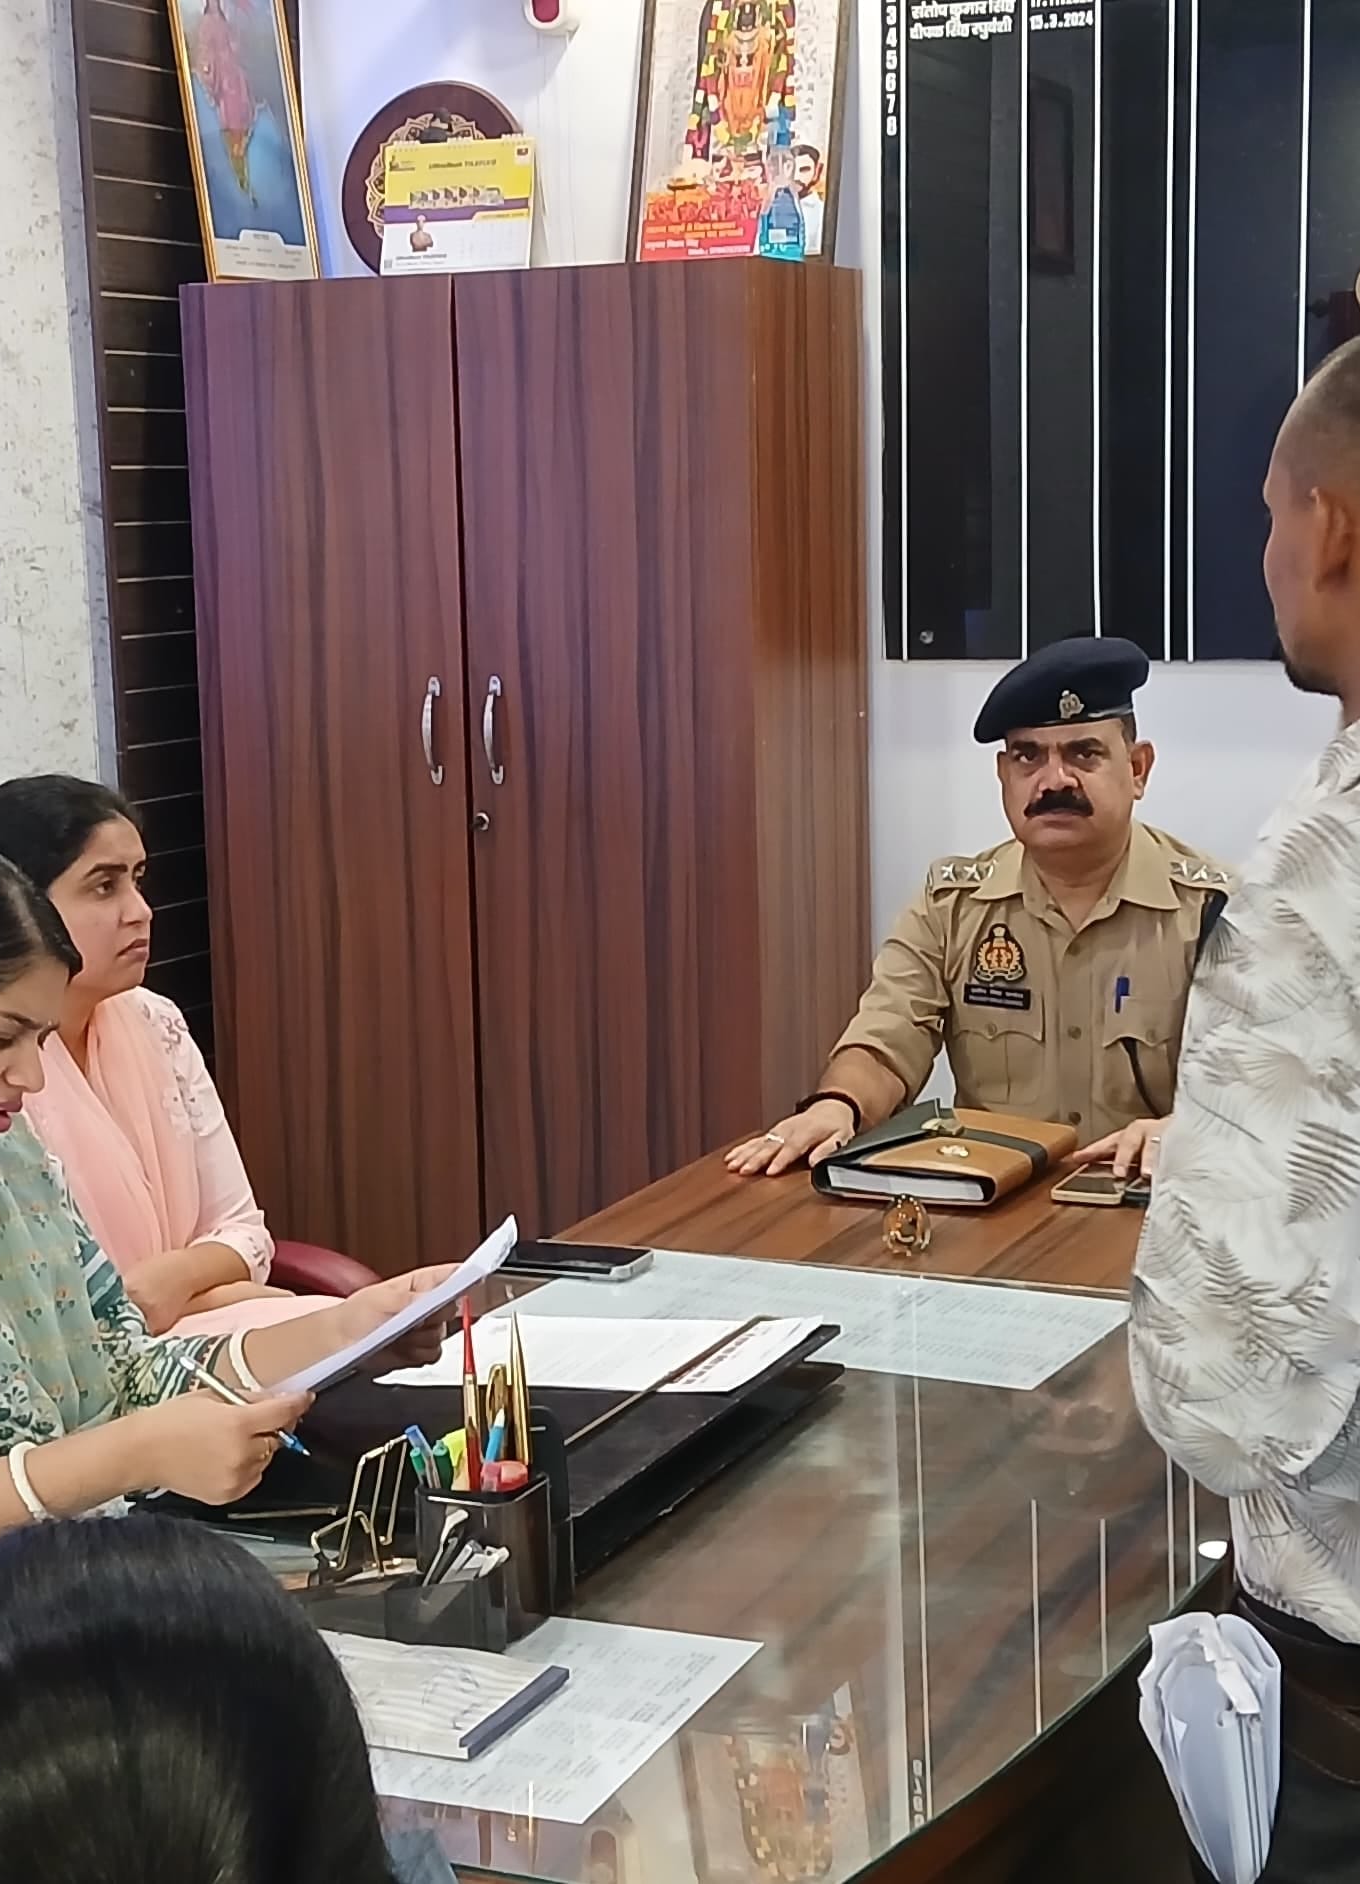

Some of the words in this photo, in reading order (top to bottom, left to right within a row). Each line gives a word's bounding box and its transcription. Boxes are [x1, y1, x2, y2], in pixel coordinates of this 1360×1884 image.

[886, 5, 897, 26] 3
[886, 27, 898, 48] 4
[886, 49, 898, 70] 5
[885, 72, 897, 92] 6
[886, 93, 897, 114] 7
